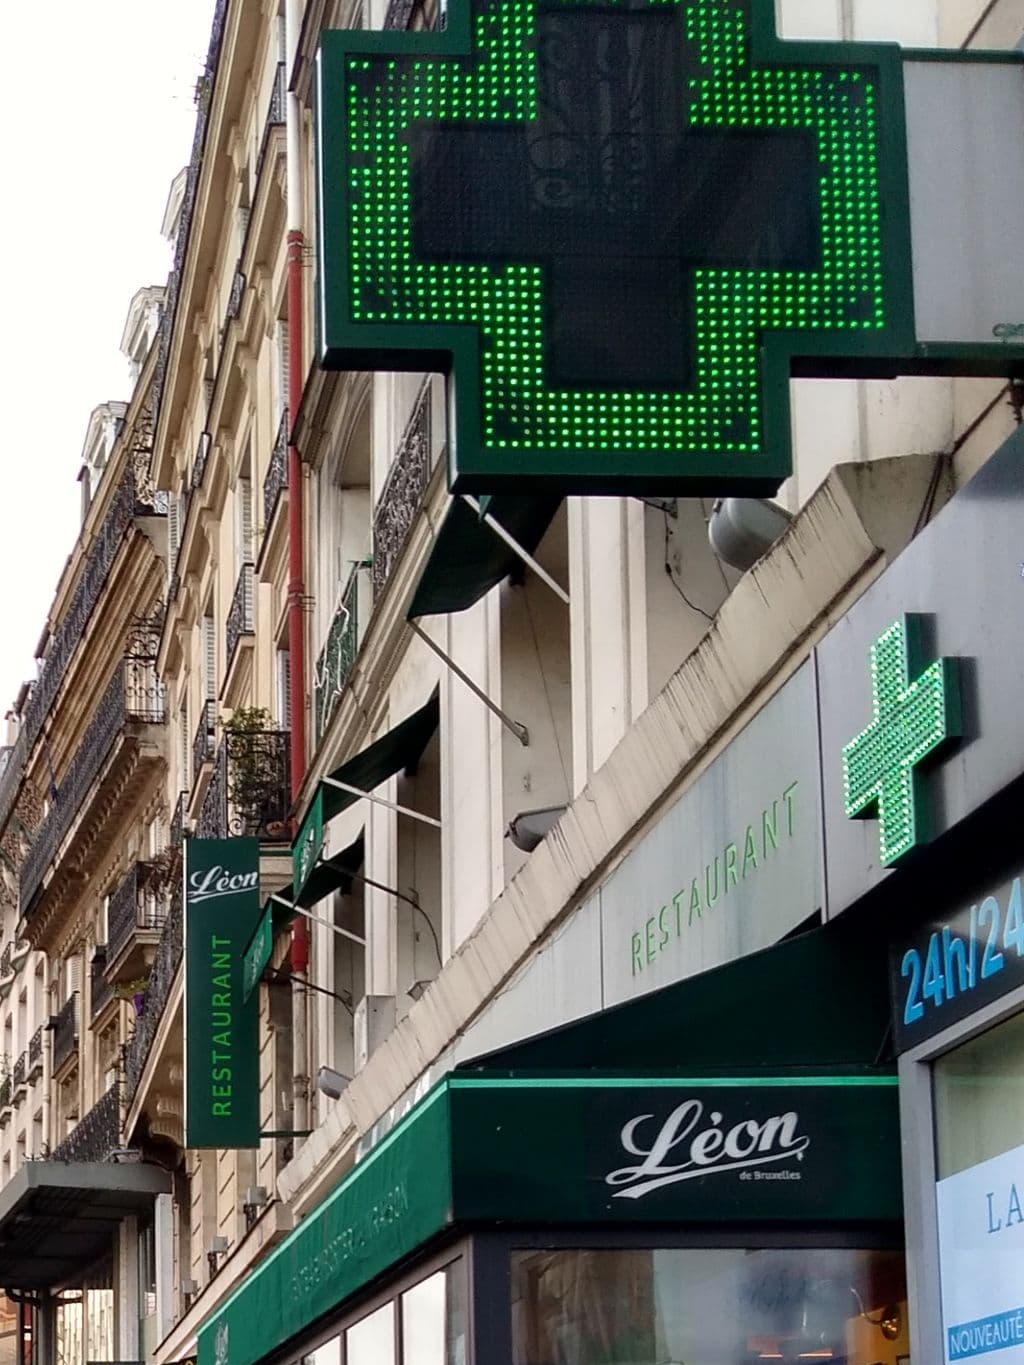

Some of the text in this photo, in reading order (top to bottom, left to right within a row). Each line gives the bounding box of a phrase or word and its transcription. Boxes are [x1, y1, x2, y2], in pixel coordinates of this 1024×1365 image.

[188, 865, 259, 903] Léon
[630, 779, 799, 976] RESTAURANT
[900, 876, 1024, 1025] 24h/24
[212, 935, 231, 1116] RESTAURANT
[605, 1099, 811, 1197] Léon
[739, 1170, 802, 1181] de Bruxelles
[951, 1311, 1023, 1356] NOUVEAUTÉ
